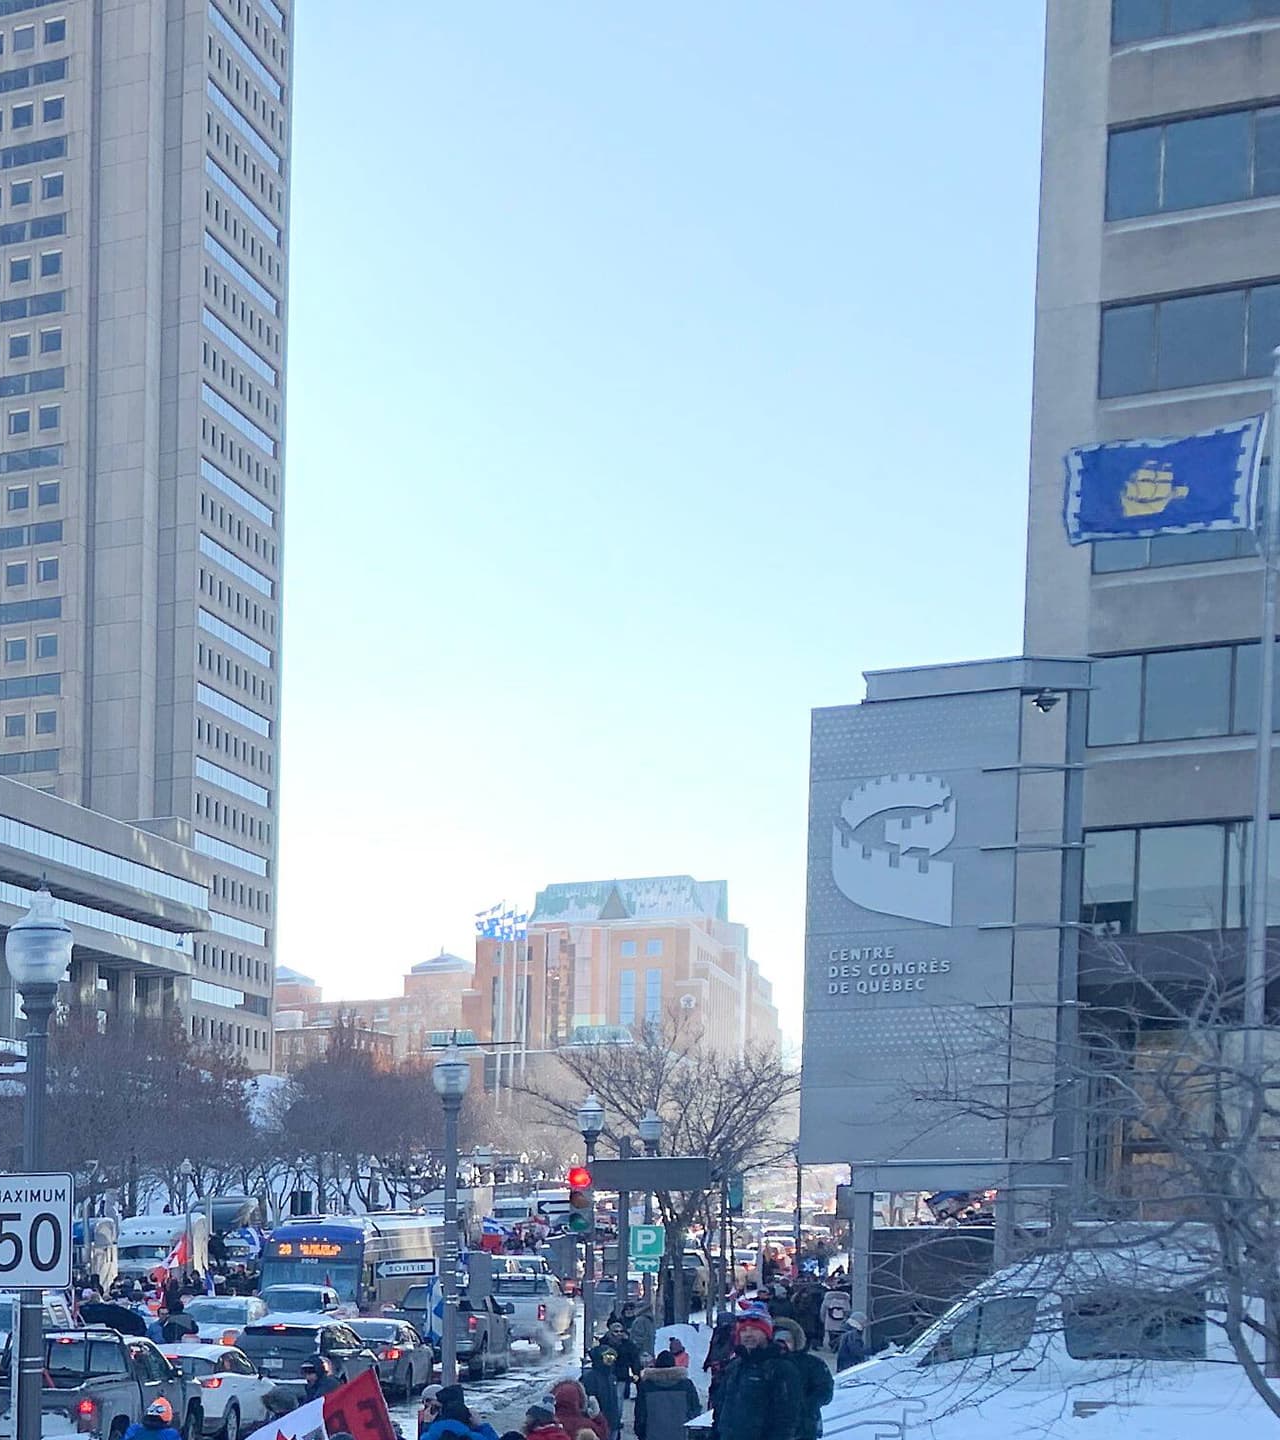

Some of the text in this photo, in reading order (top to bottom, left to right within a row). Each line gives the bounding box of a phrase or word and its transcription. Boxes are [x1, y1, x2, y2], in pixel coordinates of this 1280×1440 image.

[828, 946, 895, 961] CENTRE
[828, 957, 951, 979] DES CONGRÈS
[828, 976, 926, 994] DE QUÉBEC
[637, 1230, 656, 1252] P
